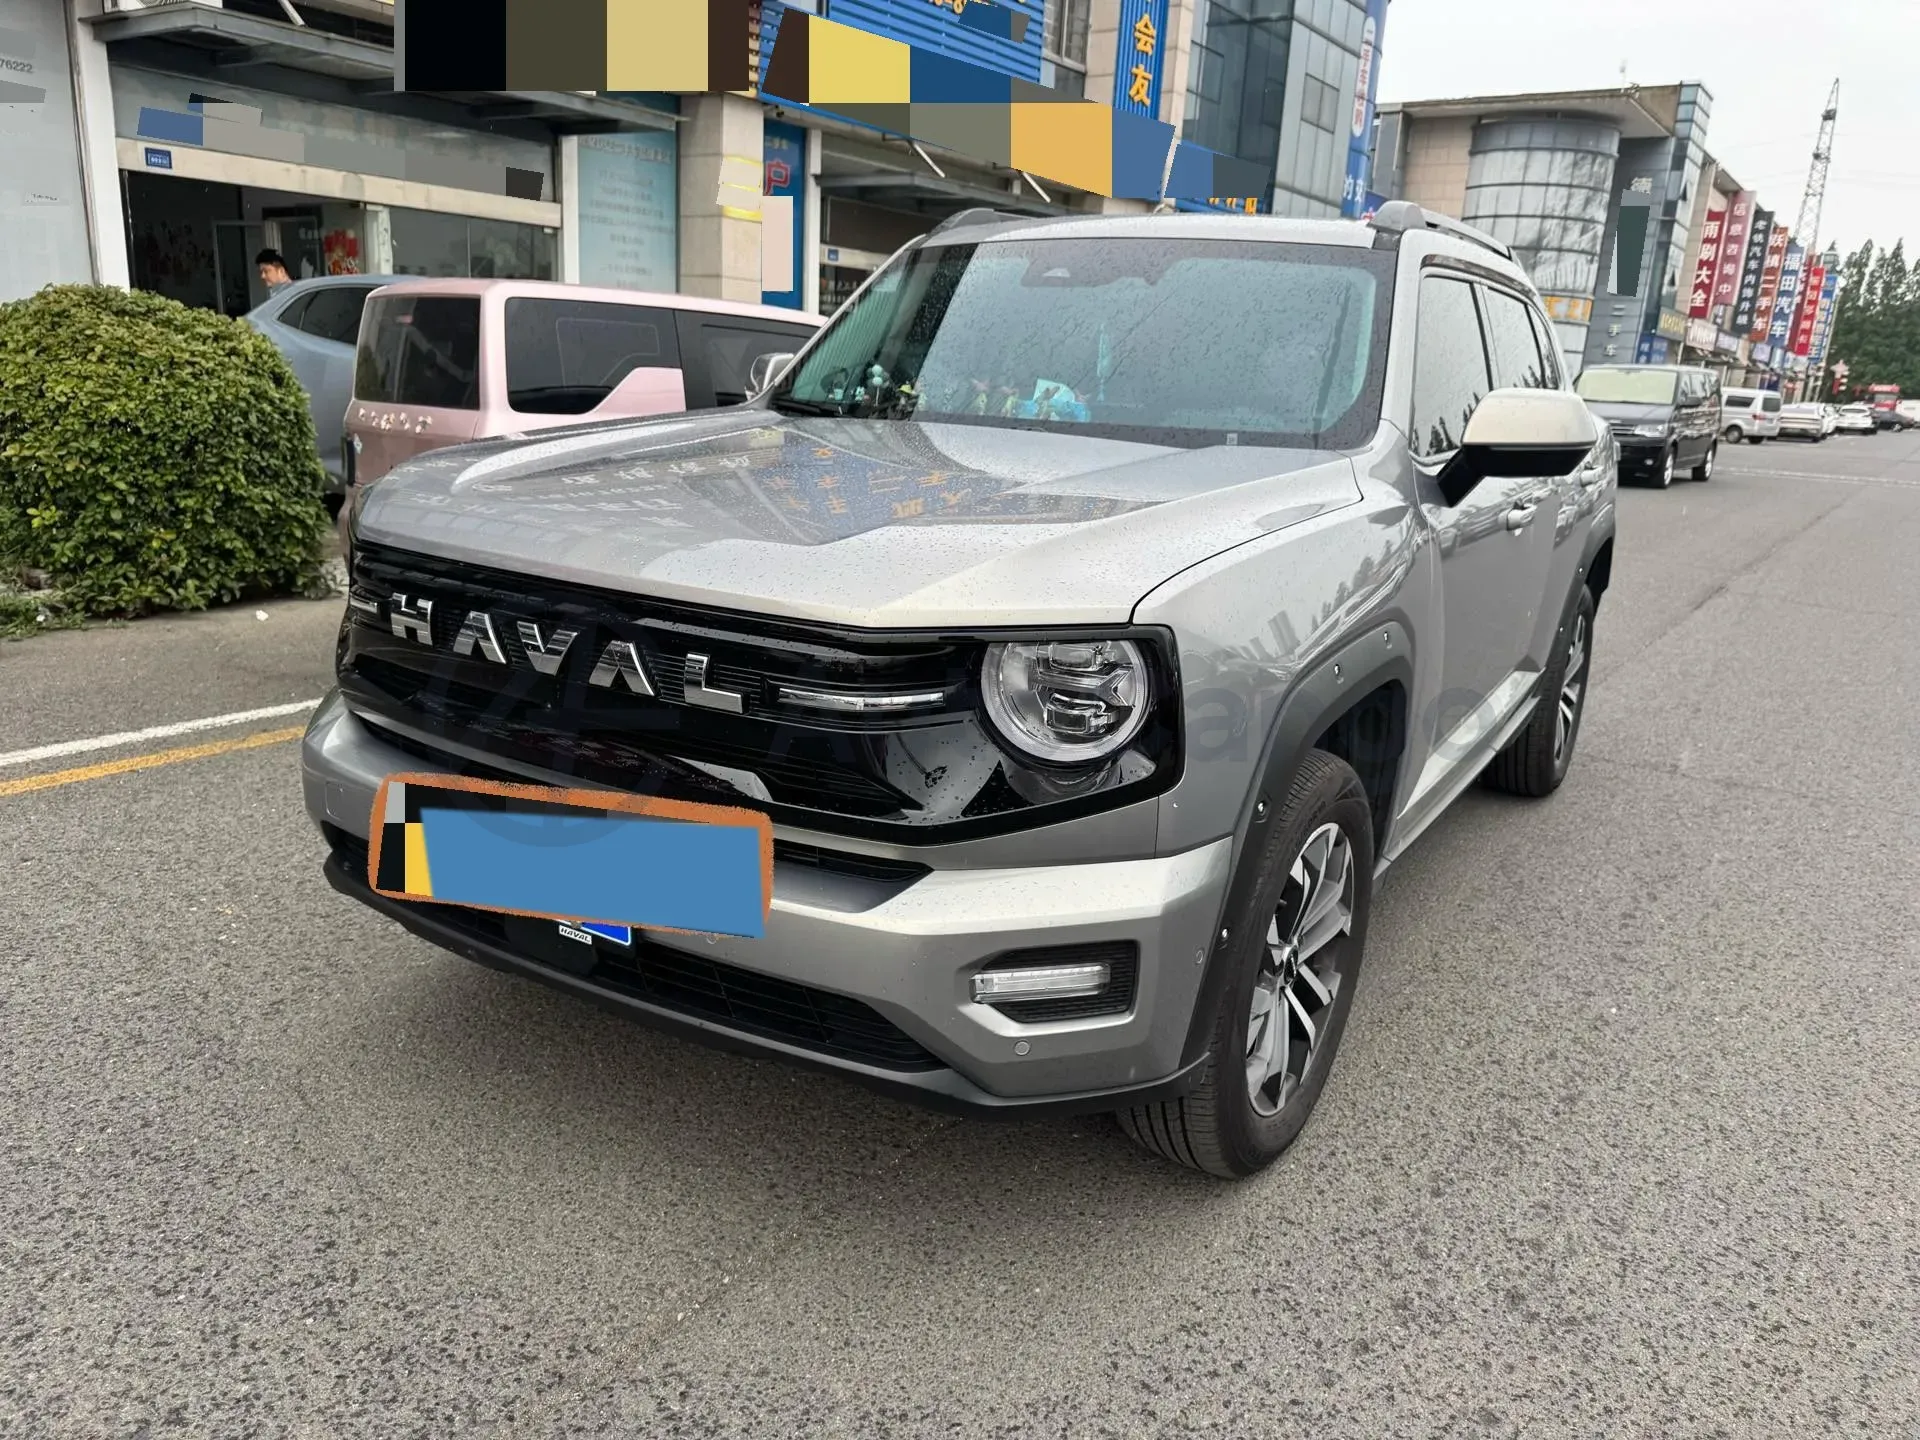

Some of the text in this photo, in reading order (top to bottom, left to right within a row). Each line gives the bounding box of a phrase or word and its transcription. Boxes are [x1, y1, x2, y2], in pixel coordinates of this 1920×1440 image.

[1690, 221, 1721, 307] 雨刷大全
[1770, 252, 1803, 339] 福田汽车
[1605, 303, 1626, 357] 二手车
[389, 592, 750, 713] HAVAL
[560, 926, 591, 943] HAVAL
